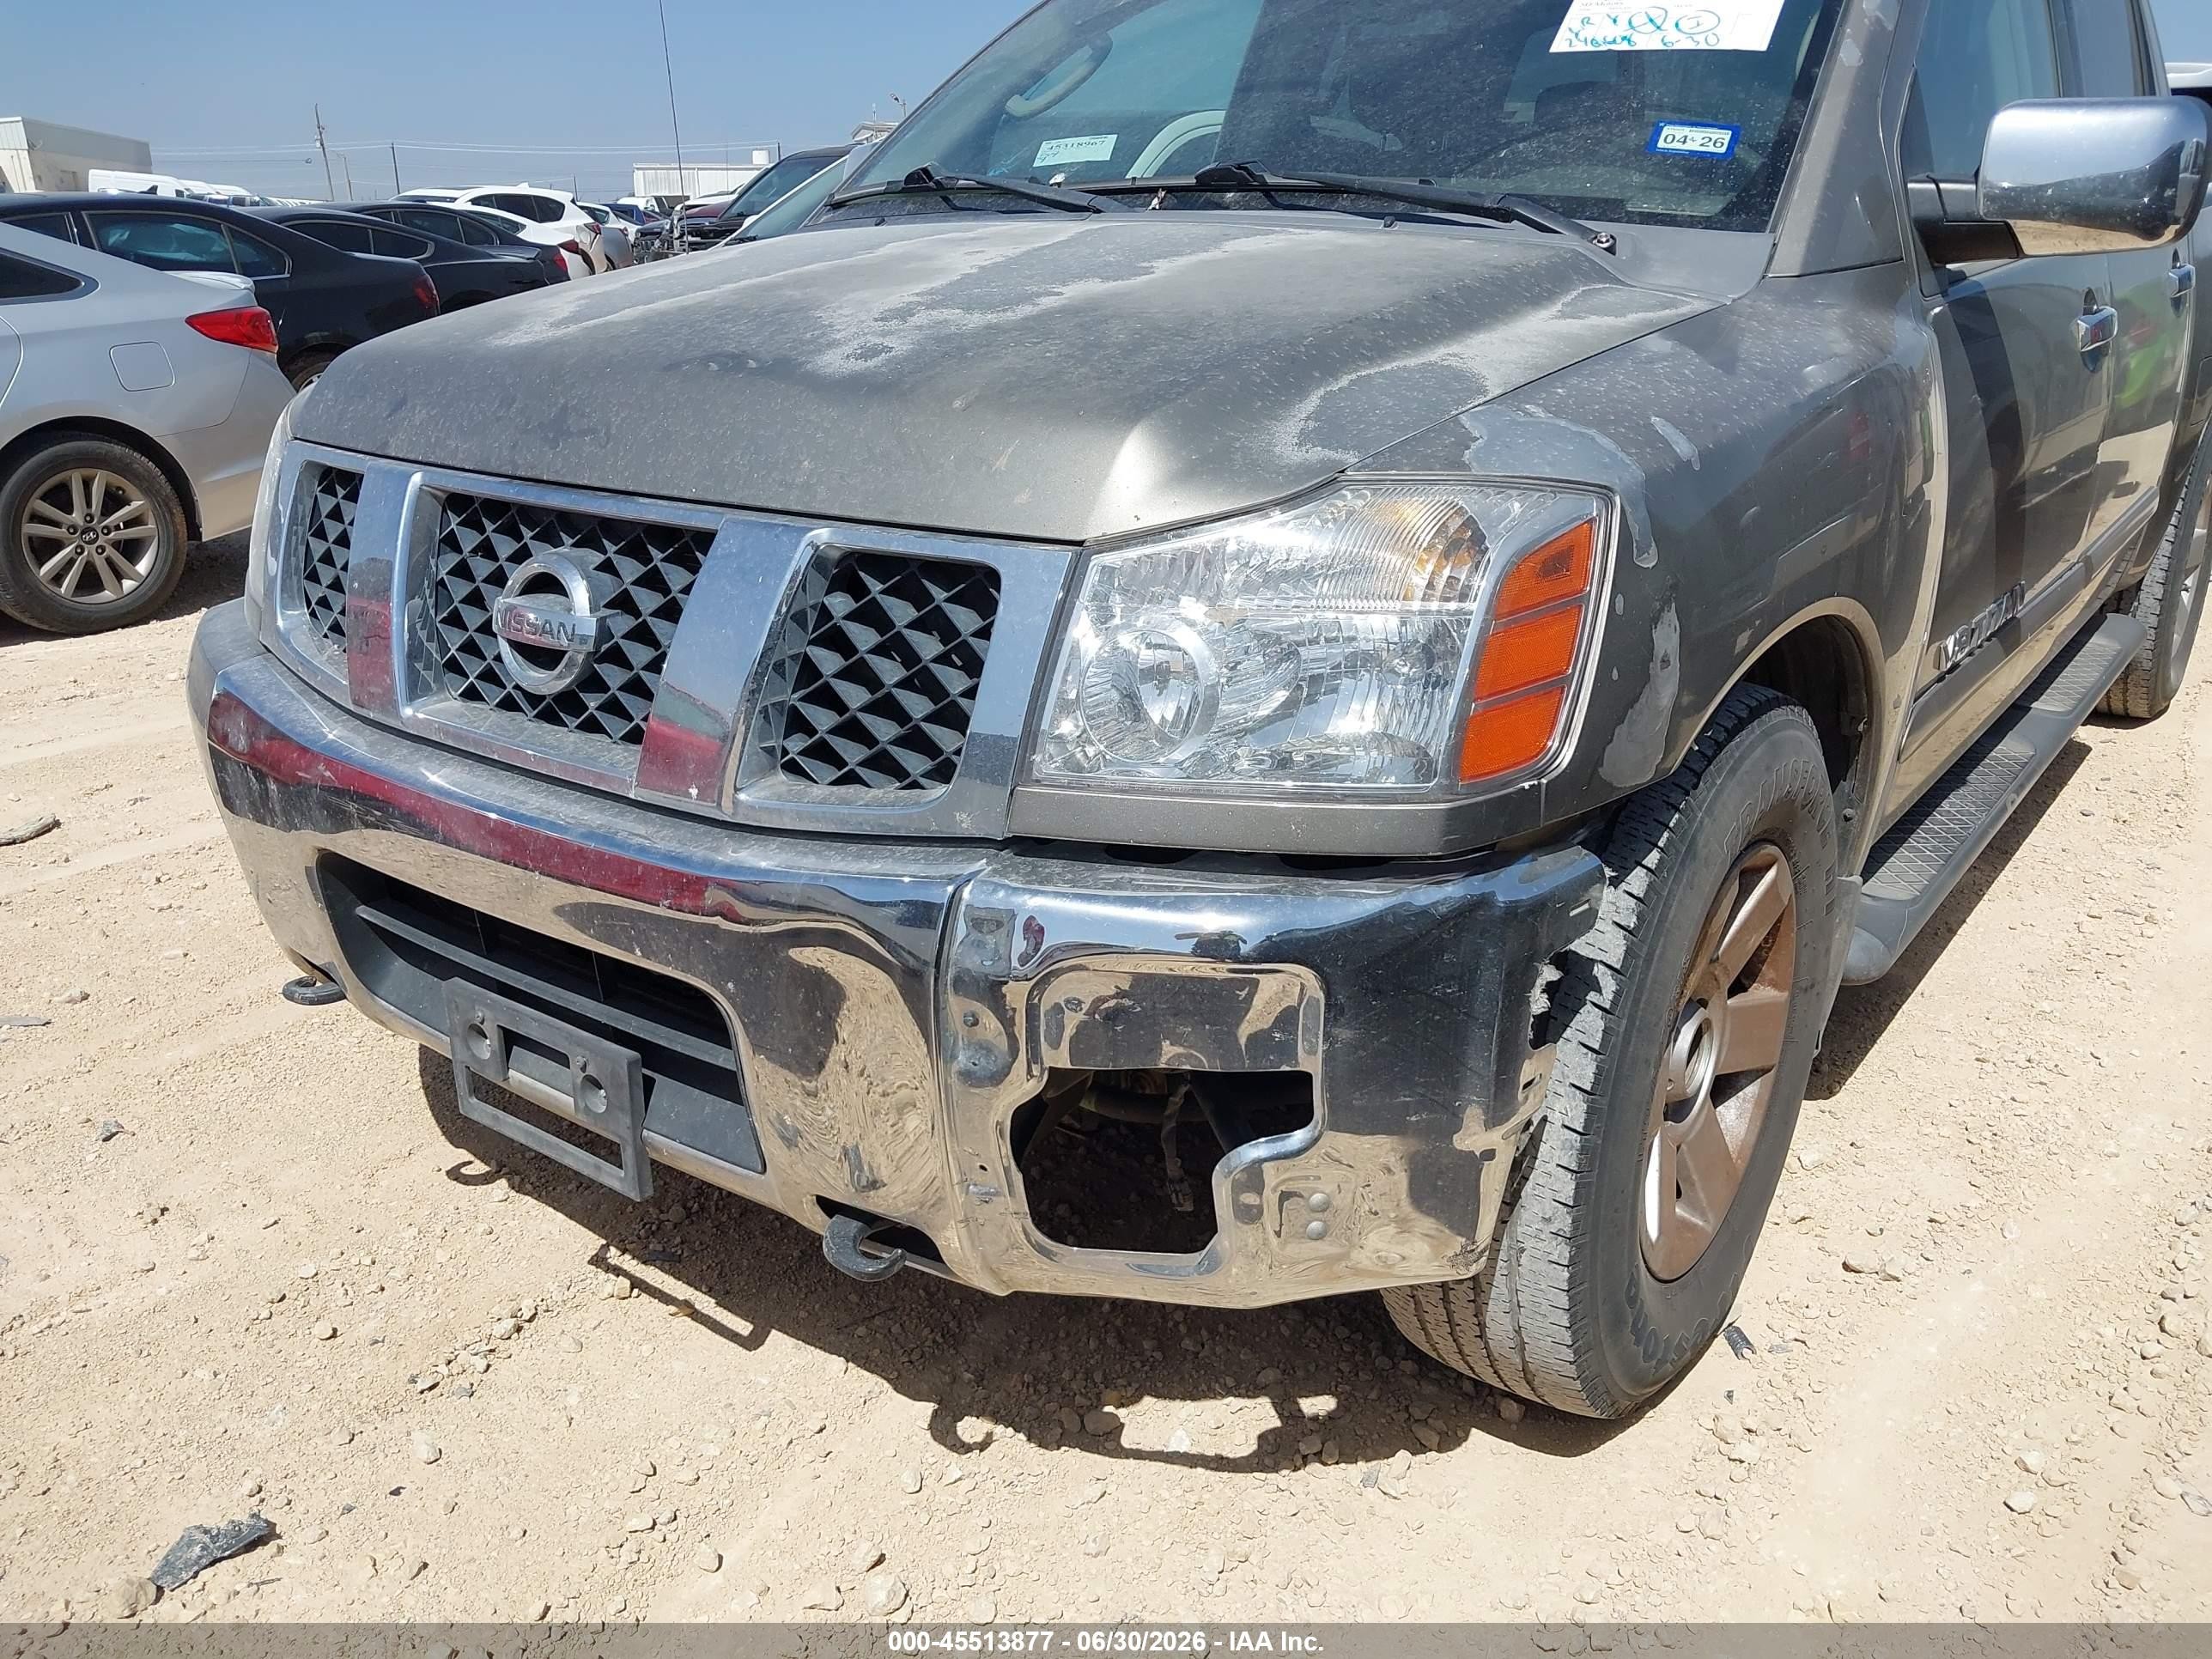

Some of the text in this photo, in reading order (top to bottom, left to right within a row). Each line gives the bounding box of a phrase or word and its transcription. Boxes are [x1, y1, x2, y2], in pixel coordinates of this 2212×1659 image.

[1663, 133, 1726, 149] 04 26
[495, 608, 577, 646] NISSAN
